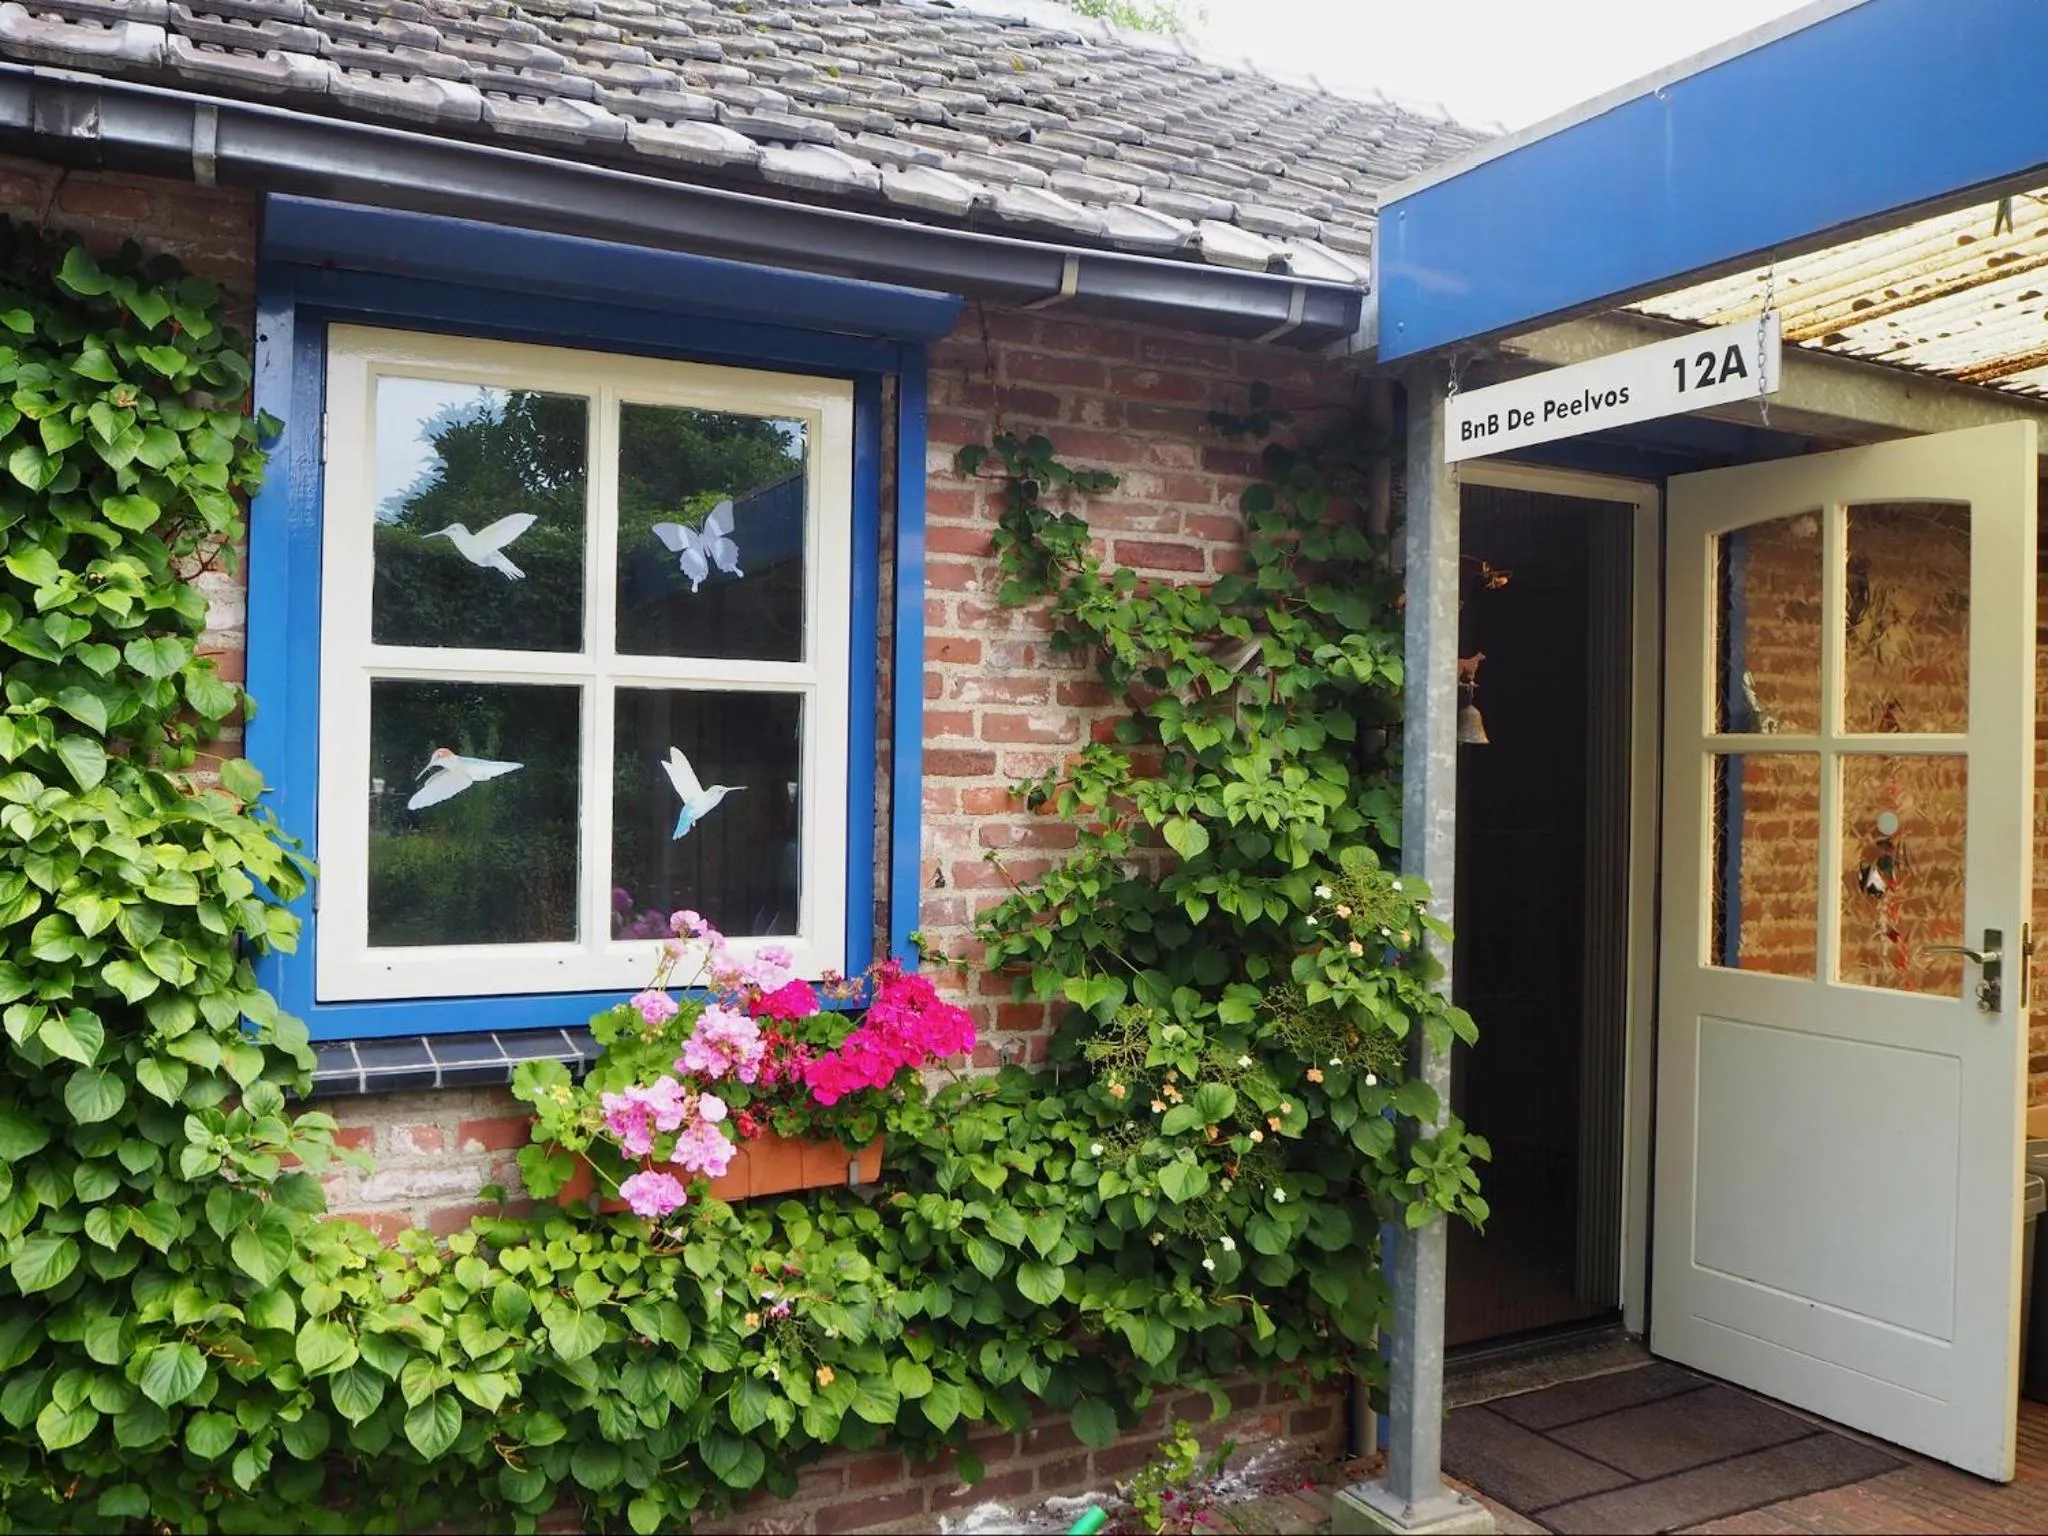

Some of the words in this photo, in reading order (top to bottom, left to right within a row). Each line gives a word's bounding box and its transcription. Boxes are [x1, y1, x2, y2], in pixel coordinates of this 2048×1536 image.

[1461, 414, 1499, 442] BnB
[1508, 408, 1535, 432] De
[1543, 386, 1630, 423] Peelvos
[1673, 344, 1749, 393] 12A
